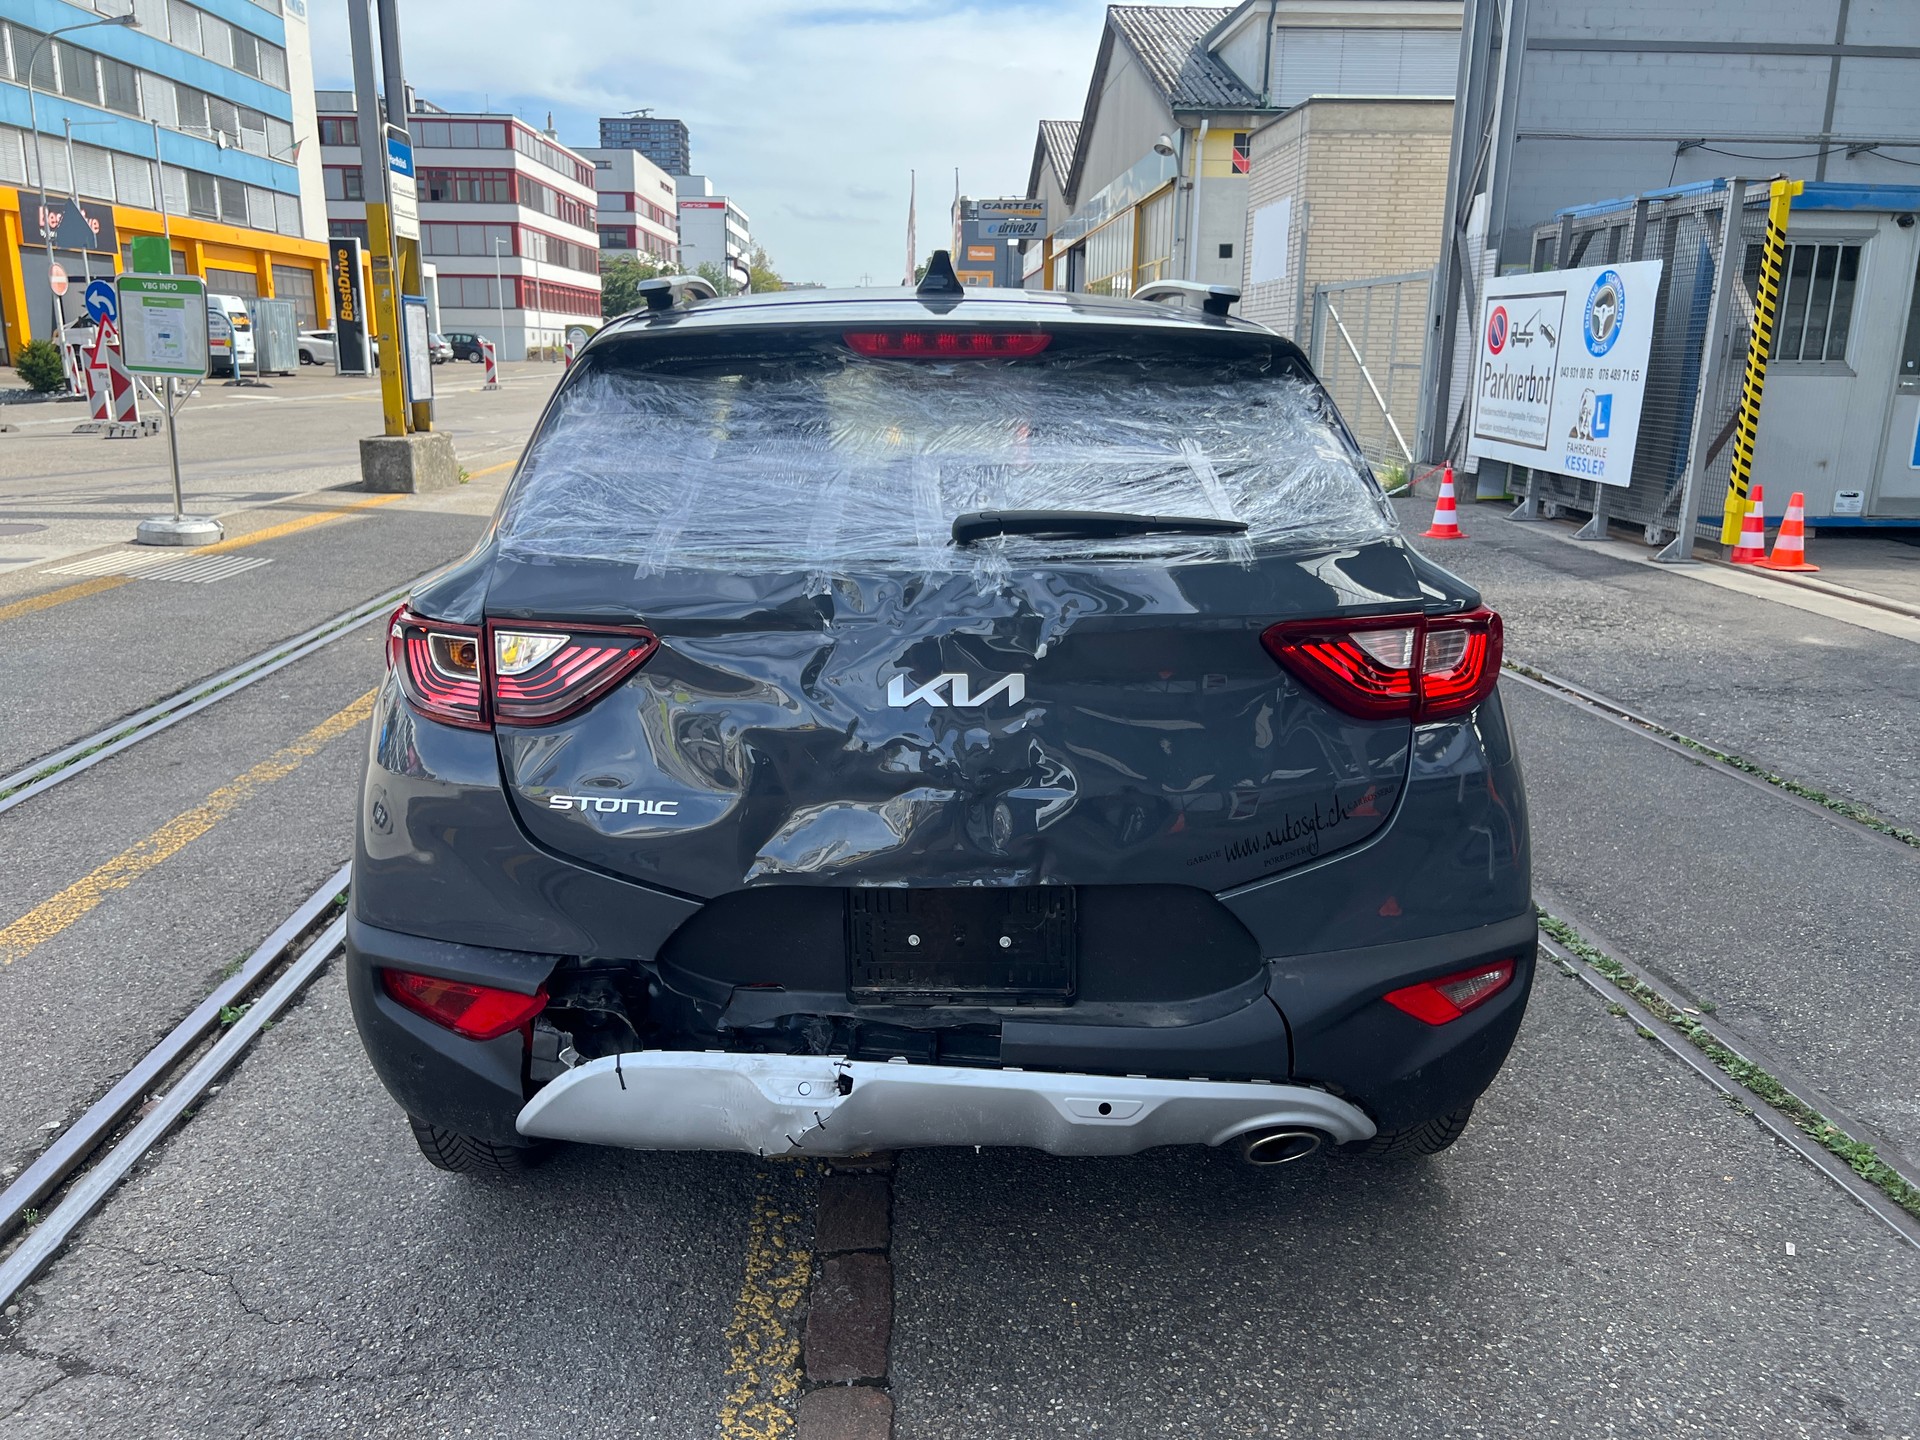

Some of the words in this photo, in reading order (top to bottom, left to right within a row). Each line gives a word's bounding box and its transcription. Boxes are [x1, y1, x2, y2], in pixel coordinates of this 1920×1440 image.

[142, 282, 158, 290] VBG
[160, 283, 178, 291] INFO
[335, 248, 354, 321] BestDrive
[1584, 283, 1599, 329] DRIVING
[1605, 272, 1624, 329] TECHNOLOGY
[1590, 342, 1608, 354] SWISS
[1482, 362, 1551, 405] Parkverbot
[1622, 369, 1630, 381] 71
[1631, 369, 1640, 381] 65
[1595, 401, 1606, 430] L
[1566, 441, 1607, 459] FAHRSCHULE
[1565, 455, 1605, 476] KESSLER
[888, 673, 1025, 707] KIA
[549, 795, 679, 816] STONIC
[1186, 849, 1221, 866] GARAGE
[1224, 794, 1350, 862] www.autosgt.ch
